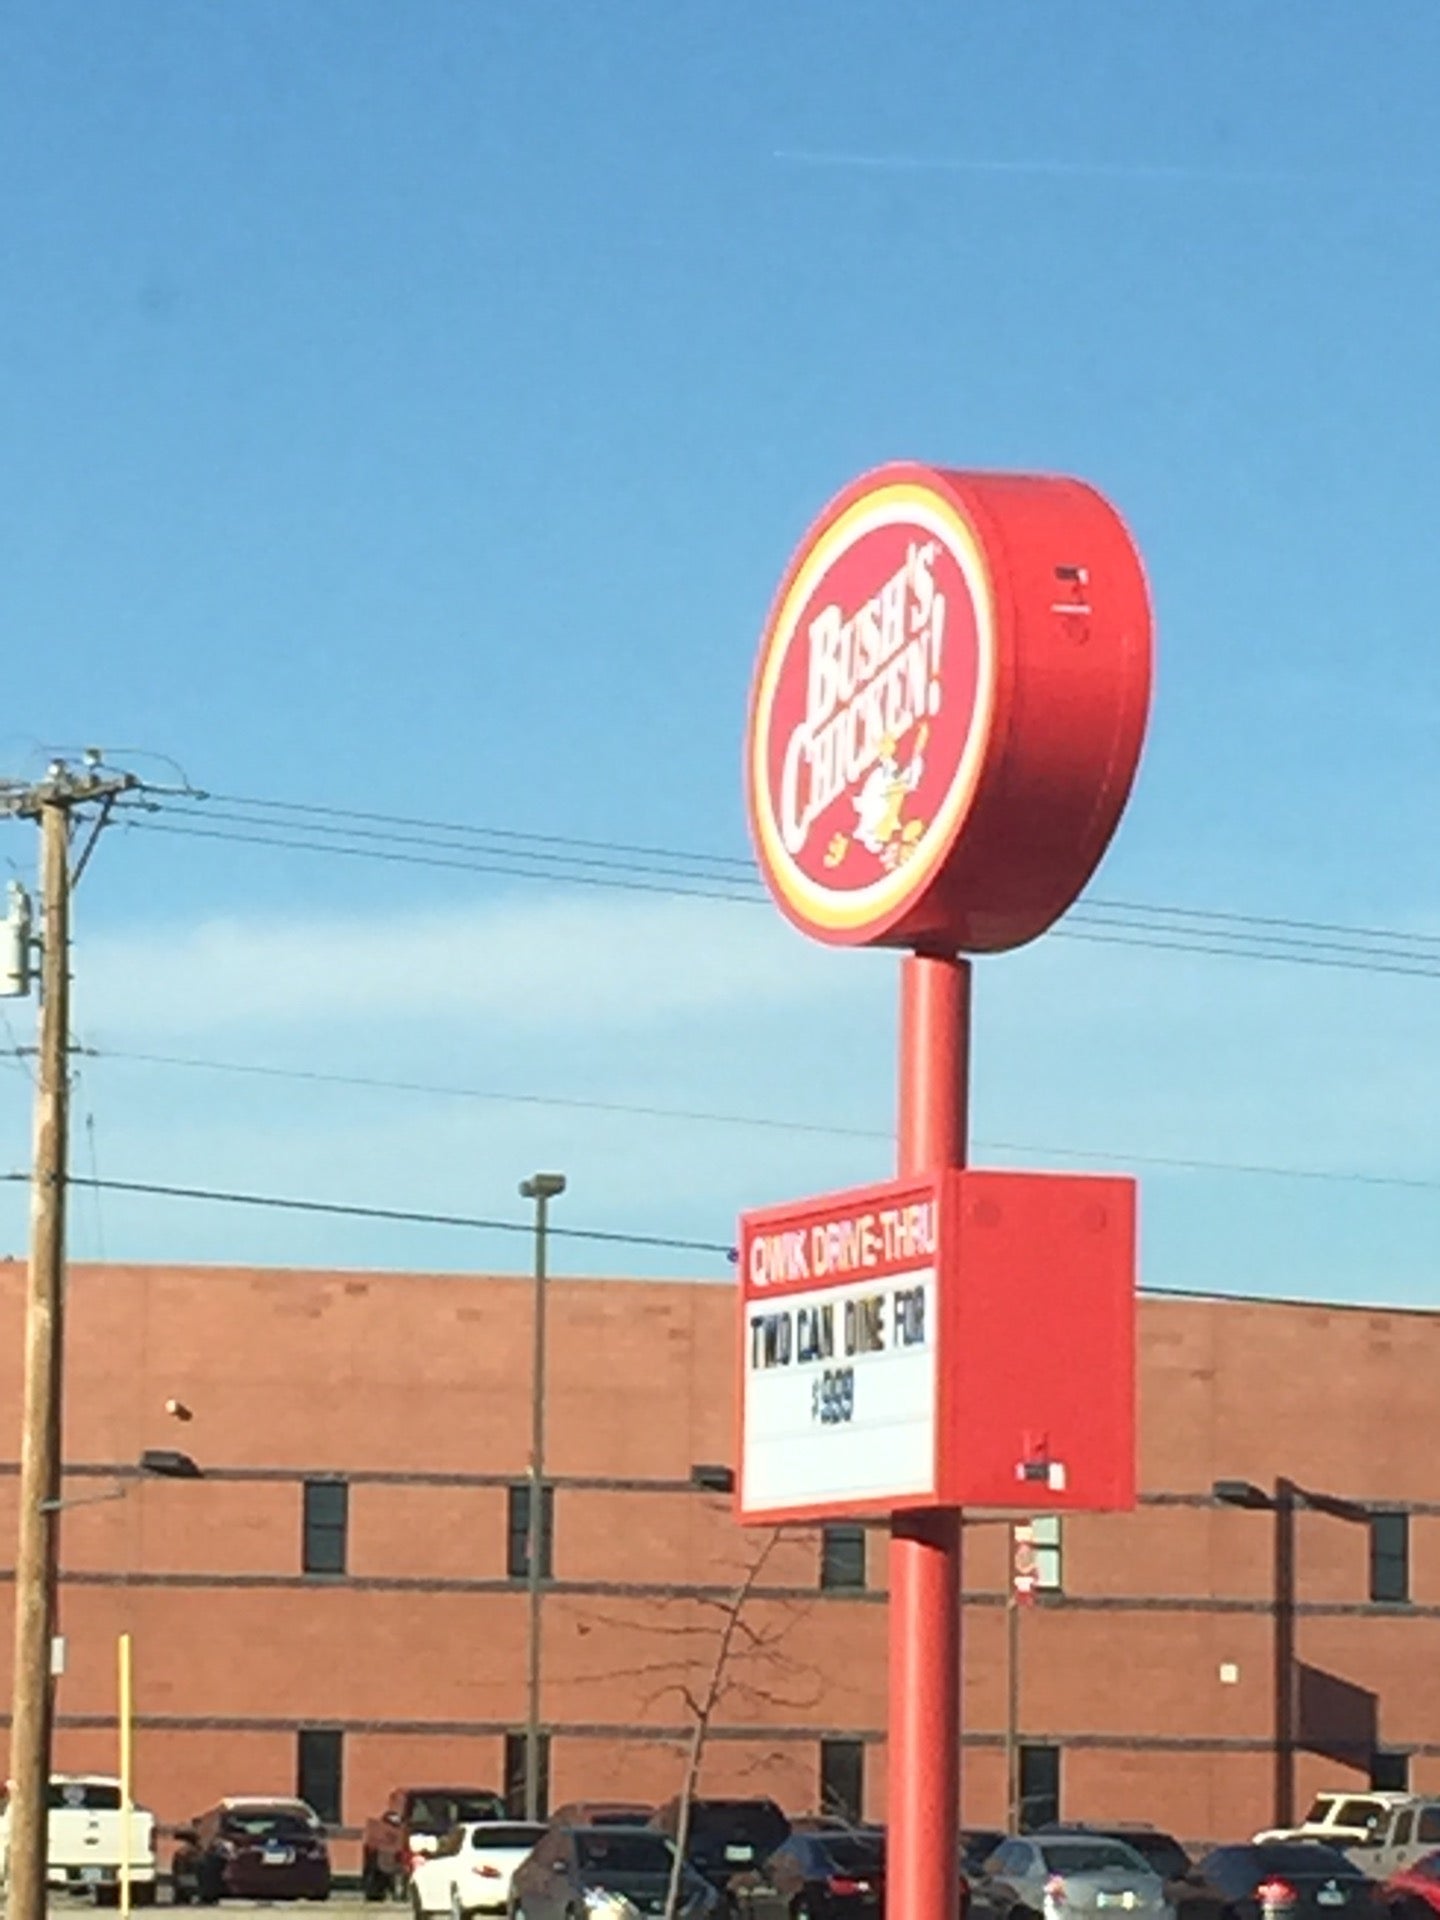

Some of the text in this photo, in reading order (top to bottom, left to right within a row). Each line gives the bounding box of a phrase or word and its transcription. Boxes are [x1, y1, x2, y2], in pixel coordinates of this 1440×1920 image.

[806, 539, 936, 728] BUSH'S
[780, 592, 946, 855] CHICKEN!
[750, 1201, 937, 1287] QWIK DRIVE-THRU
[751, 1285, 925, 1369] TWO CAN DINE FOR
